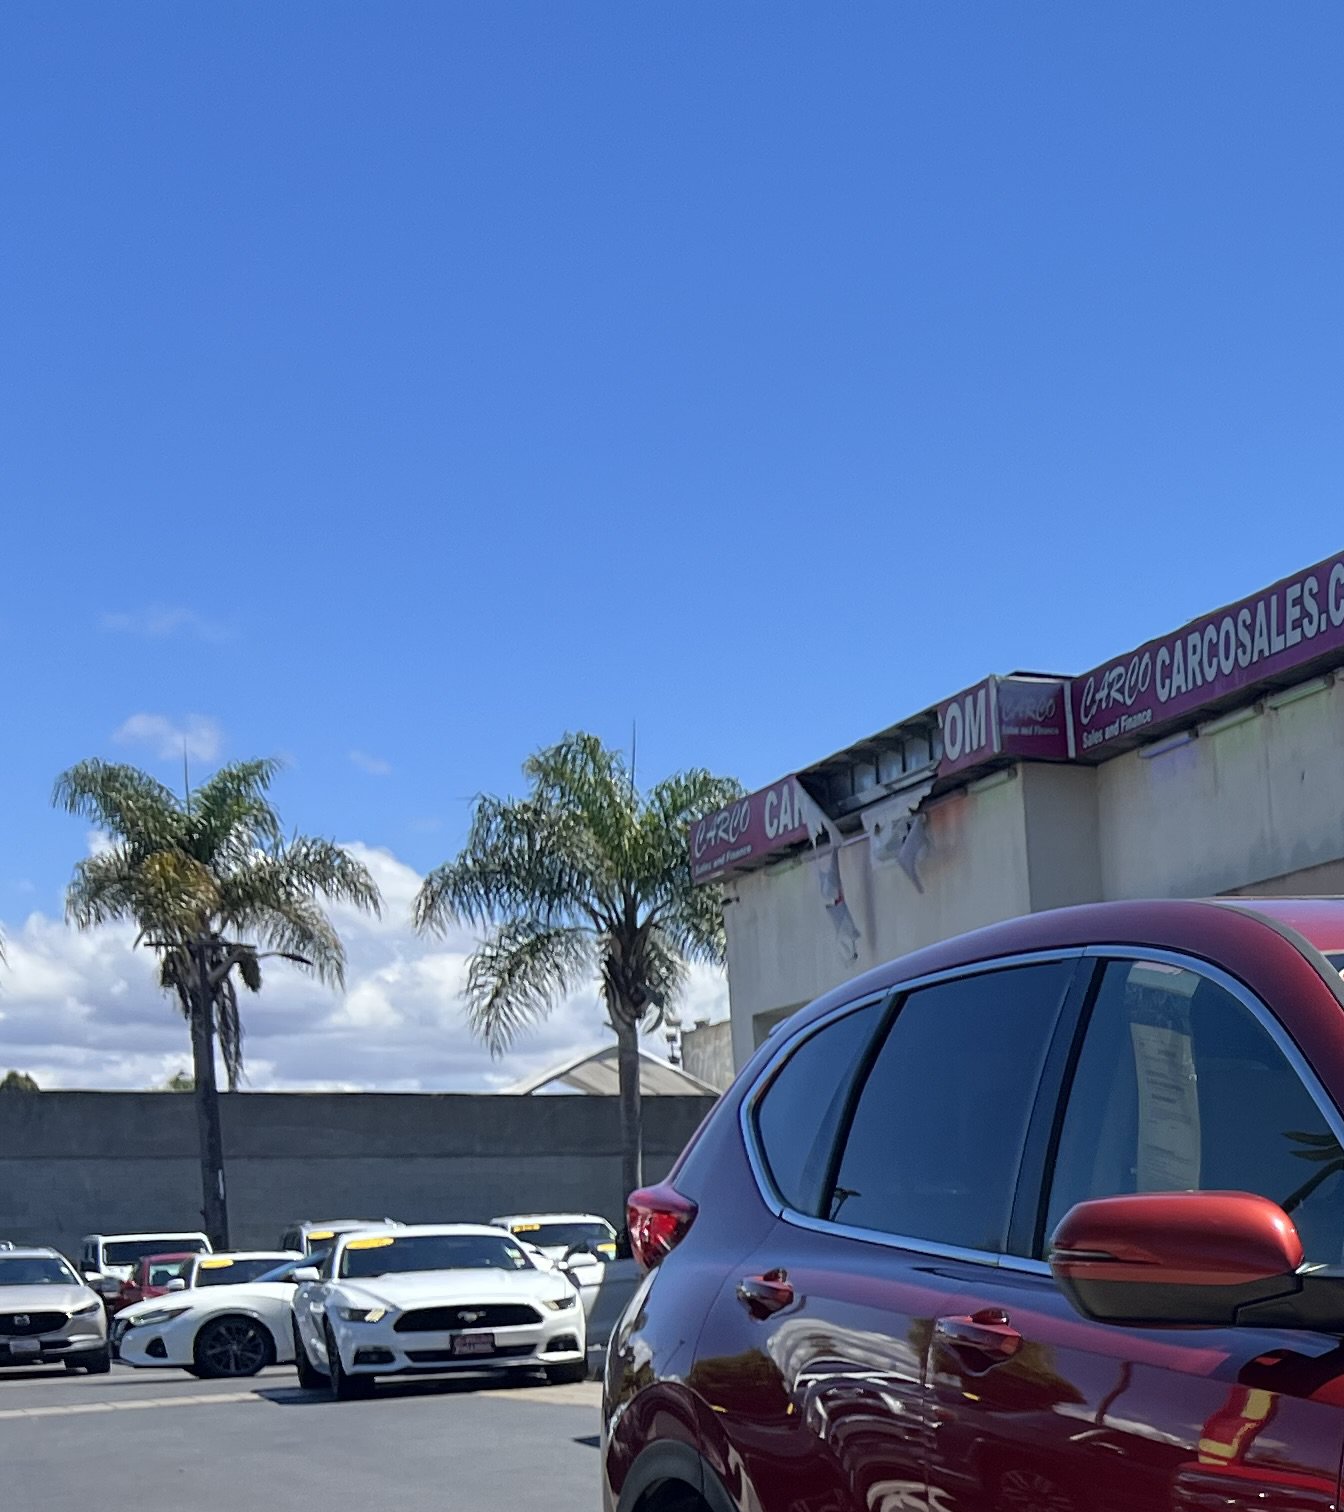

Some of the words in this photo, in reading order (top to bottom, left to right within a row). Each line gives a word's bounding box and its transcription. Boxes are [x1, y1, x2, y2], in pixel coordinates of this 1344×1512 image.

[1080, 651, 1152, 726] CARCO
[1082, 731, 1104, 749] Sales
[1105, 720, 1120, 740] and
[1120, 708, 1153, 733] Finance
[695, 800, 750, 859] CARCO
